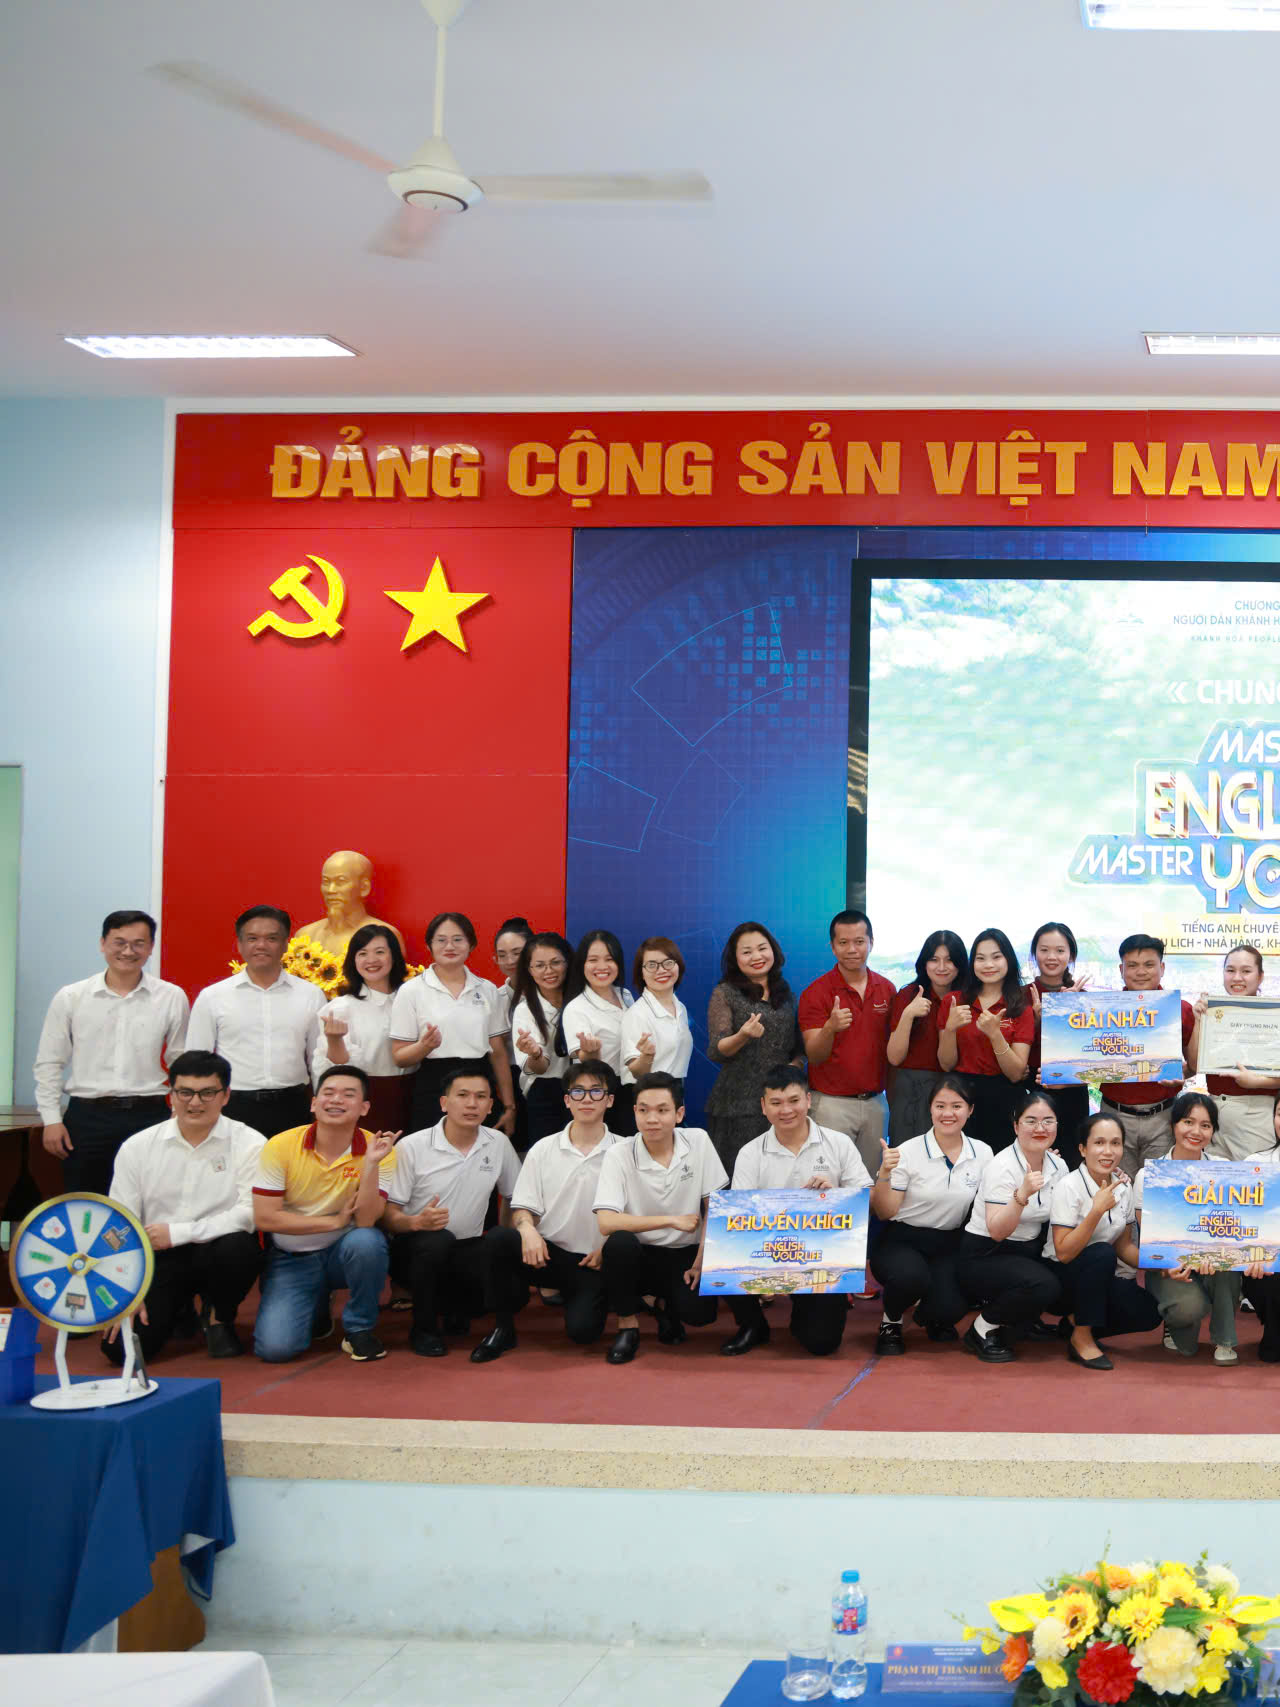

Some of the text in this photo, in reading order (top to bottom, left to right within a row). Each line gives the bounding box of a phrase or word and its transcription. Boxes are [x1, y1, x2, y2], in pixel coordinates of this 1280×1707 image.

[269, 426, 480, 498] ĐẢNG
[508, 430, 713, 507] CỘNG
[738, 422, 900, 495] SẢN
[926, 430, 1087, 505] VIỆT
[1075, 844, 1194, 876] MASTER
[1181, 918, 1215, 933] TIẾNG
[1217, 923, 1240, 934] ANH
[1170, 938, 1195, 950] LỊCH
[1204, 935, 1228, 948] NHÀ
[1068, 1005, 1159, 1029] GIẢI NHẤT
[1092, 1037, 1129, 1046] ENGLISH
[1100, 1045, 1131, 1057] YOUR
[1184, 1179, 1224, 1205] GIẢI
[726, 1208, 853, 1232] KHUYẾN KHÍCH
[1199, 1215, 1241, 1227] ENGLISH
[1208, 1226, 1244, 1240] YOUR
[1241, 1228, 1258, 1237] LIFE
[763, 1241, 805, 1252] ENGLISH
[772, 1251, 808, 1264] YOUR
